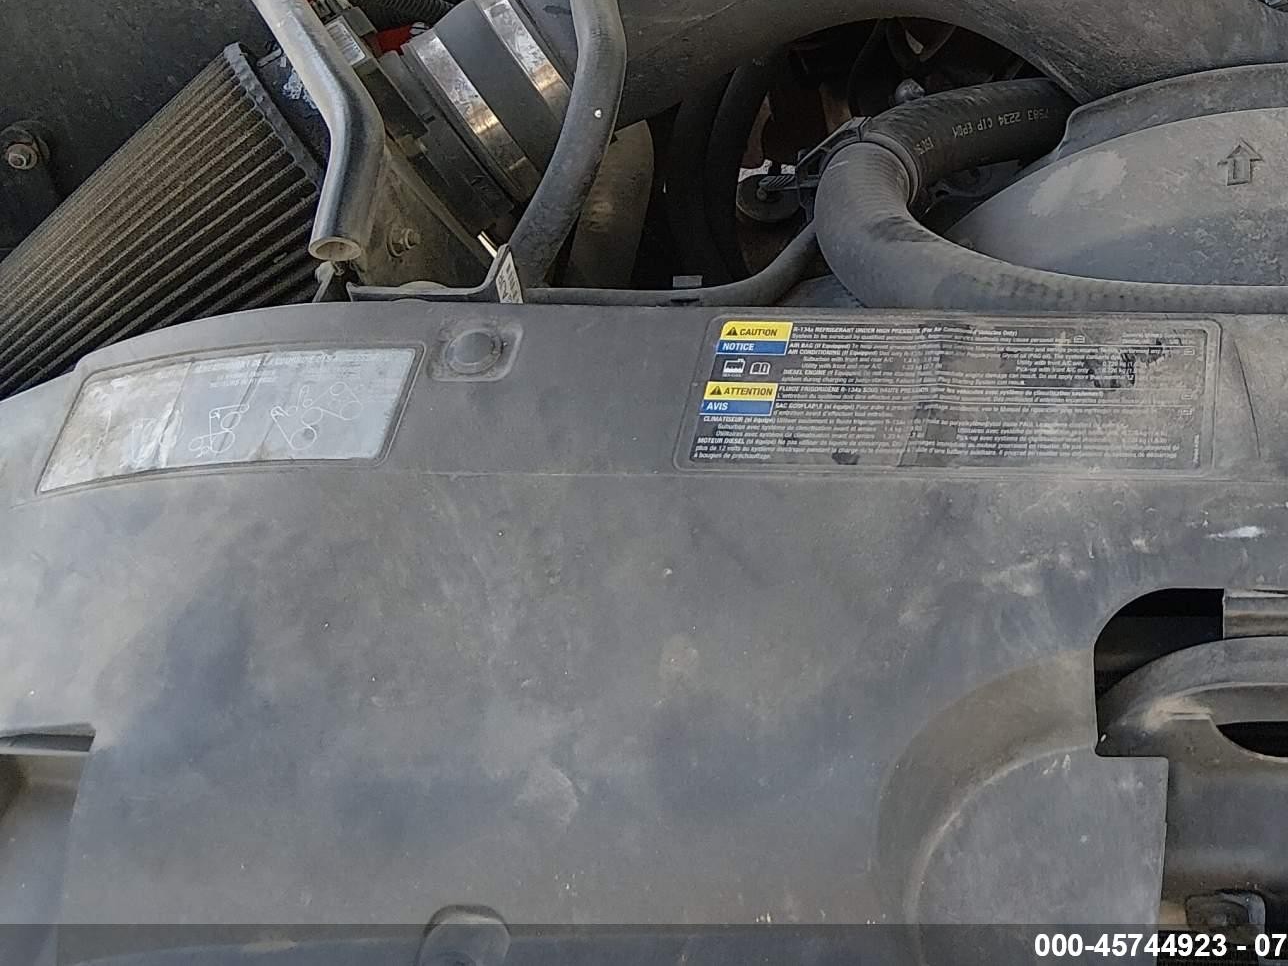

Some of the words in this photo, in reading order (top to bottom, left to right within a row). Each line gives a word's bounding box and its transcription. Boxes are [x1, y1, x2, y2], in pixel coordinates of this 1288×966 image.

[997, 111, 1022, 127] 2234
[739, 328, 778, 337] CAUTION
[722, 343, 754, 351] NOTICE
[724, 387, 773, 396] ATTENTION
[706, 402, 728, 411] AVIS
